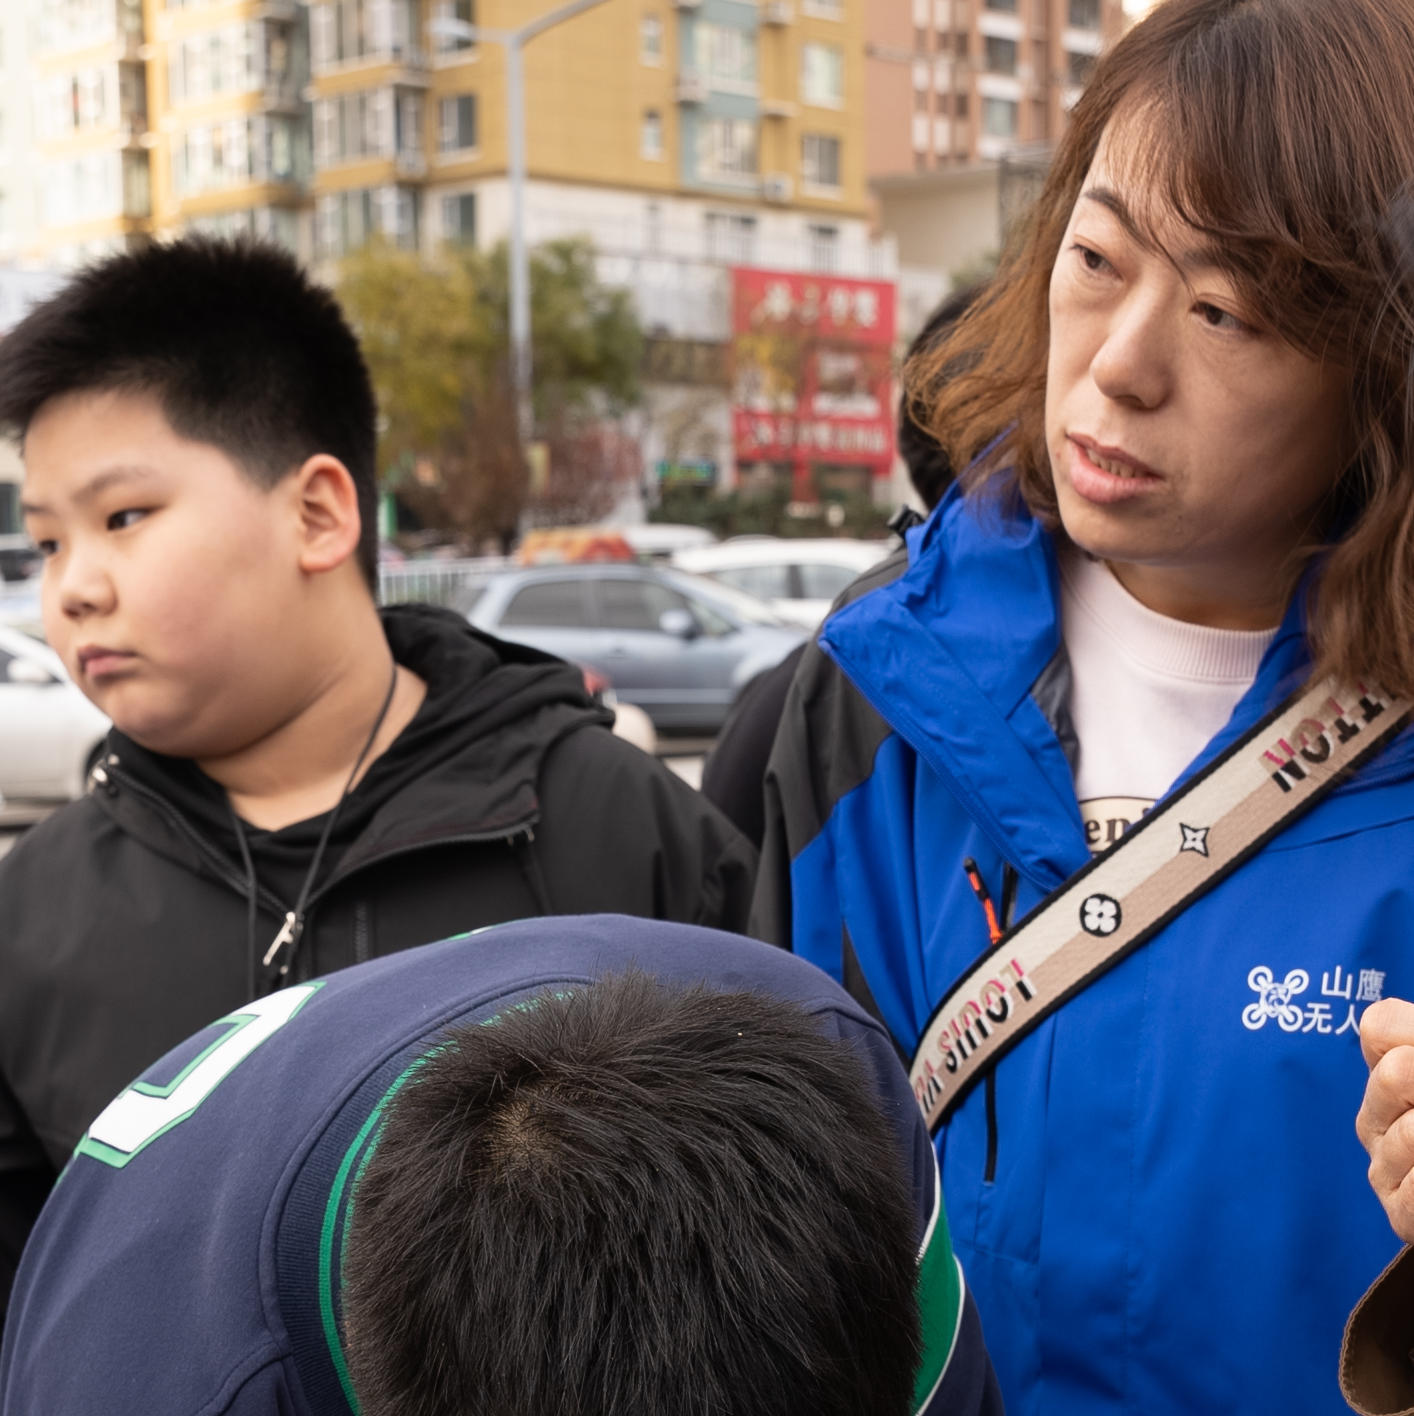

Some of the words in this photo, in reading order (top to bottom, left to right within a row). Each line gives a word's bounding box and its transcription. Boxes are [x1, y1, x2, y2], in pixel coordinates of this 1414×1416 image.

[1320, 964, 1387, 1002] 山鹰
[937, 958, 1038, 1074] LOUIS
[1301, 1002, 1361, 1036] 无人
